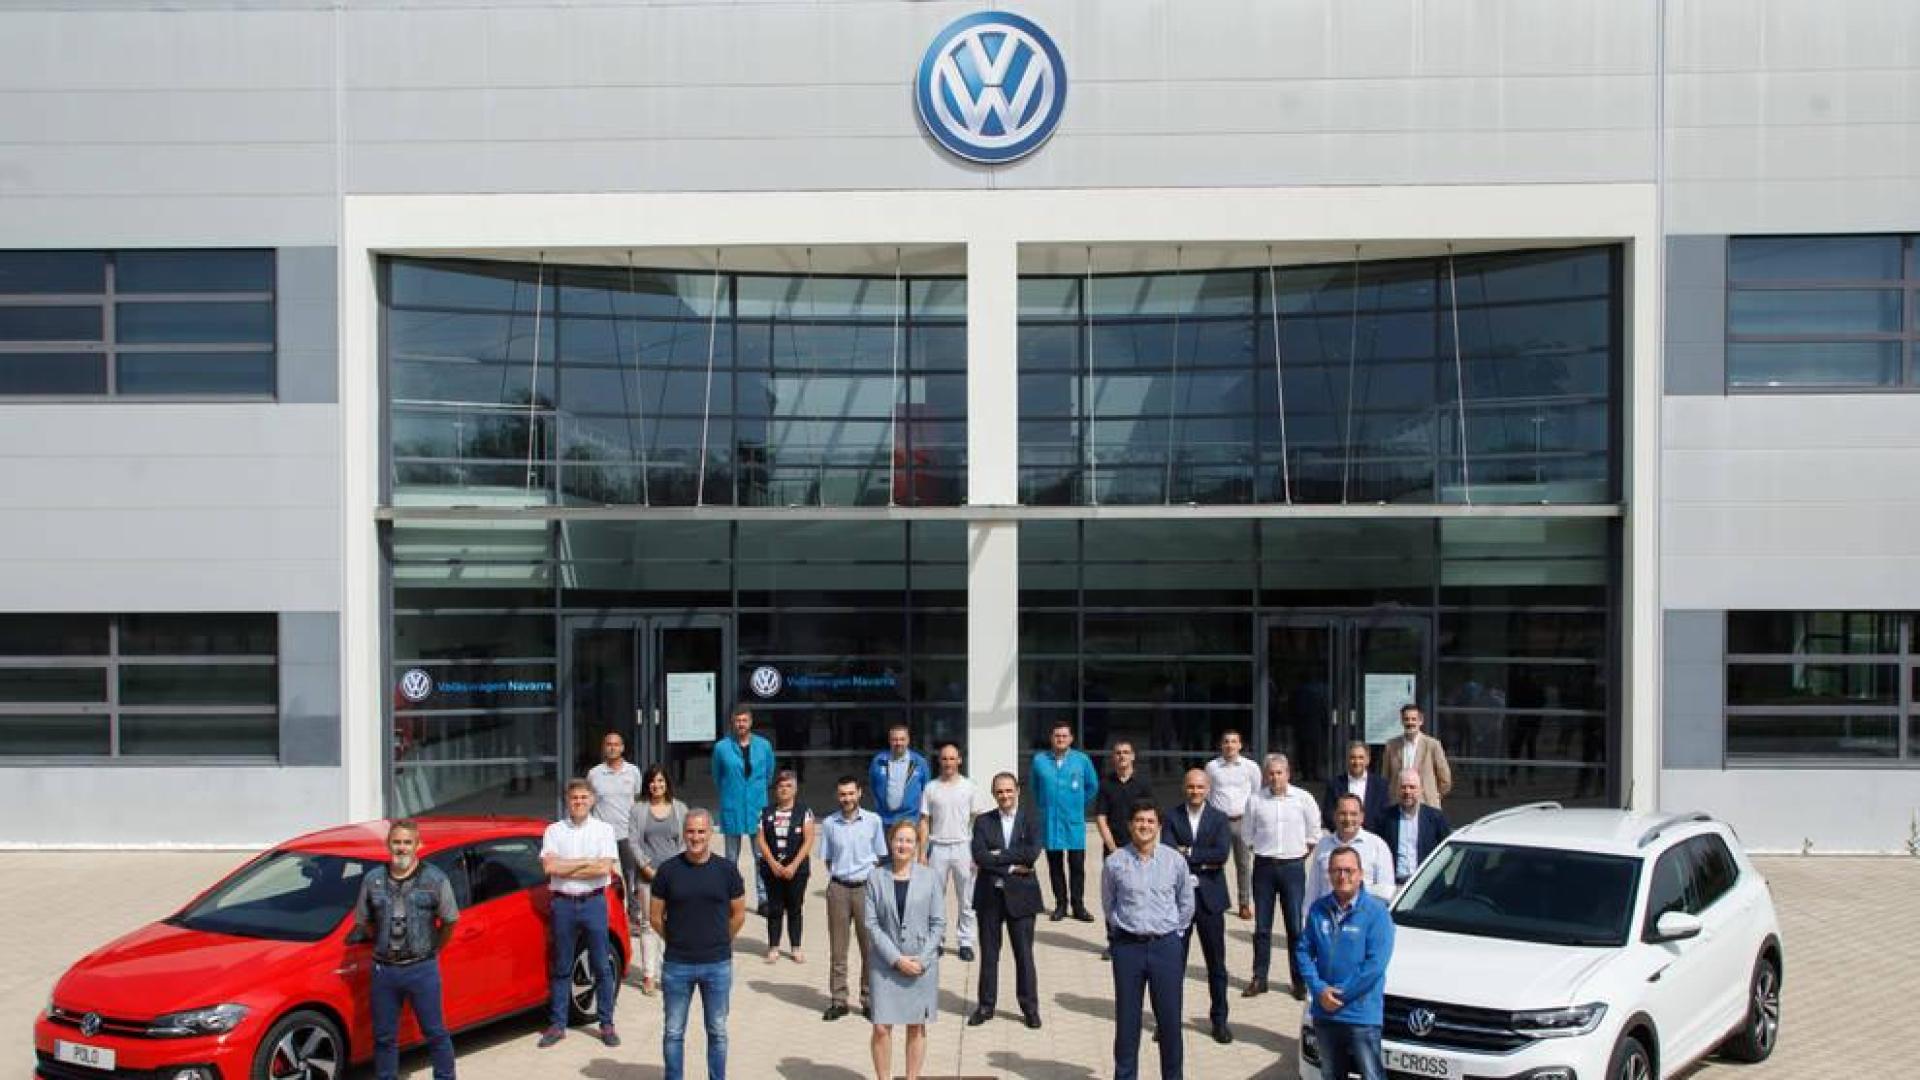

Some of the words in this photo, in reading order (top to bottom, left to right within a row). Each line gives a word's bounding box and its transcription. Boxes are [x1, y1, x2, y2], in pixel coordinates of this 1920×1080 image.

[508, 680, 552, 691] Navarra
[73, 1046, 100, 1065] POLO
[1384, 1050, 1448, 1075] T-CROSS
